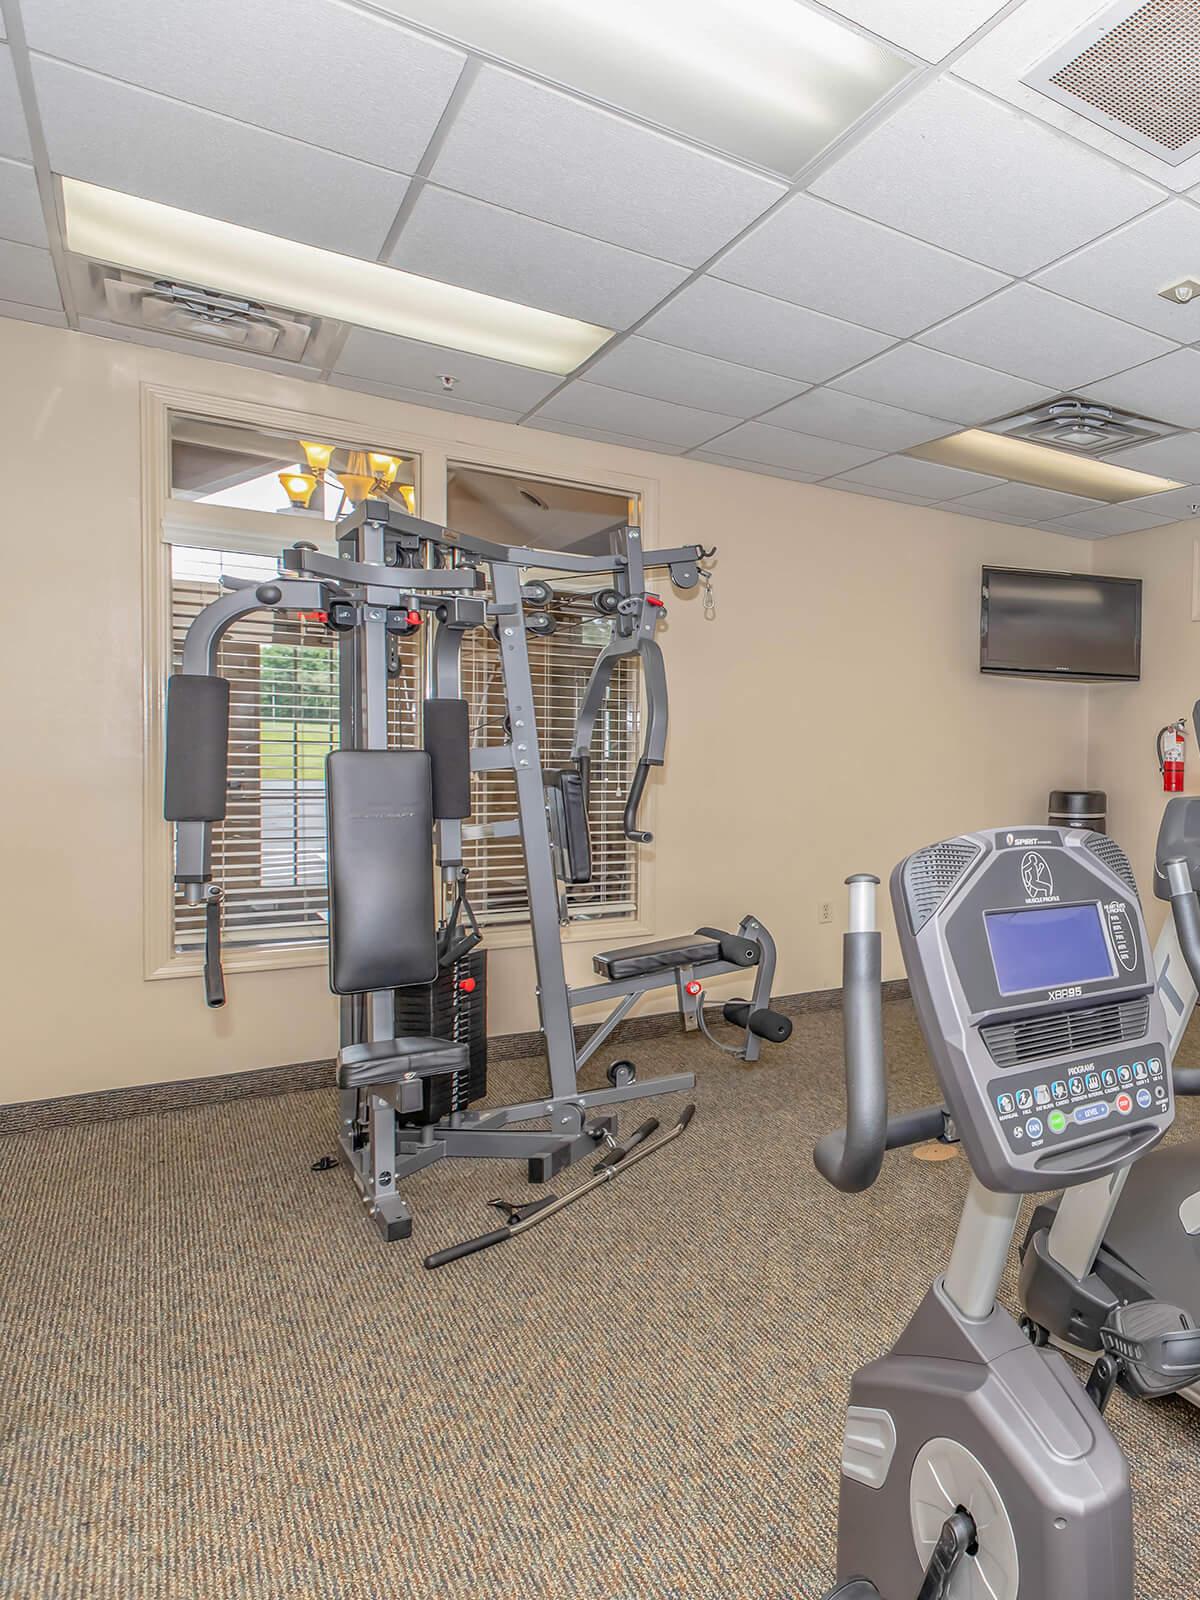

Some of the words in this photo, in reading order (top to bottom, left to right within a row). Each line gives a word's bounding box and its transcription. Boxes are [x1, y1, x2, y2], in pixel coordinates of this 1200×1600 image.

[1014, 838, 1039, 846] SPIRIT
[1068, 1063, 1095, 1076] PROGRAMS
[1084, 1107, 1098, 1118] LEVEL
[1029, 1124, 1040, 1132] FAN
